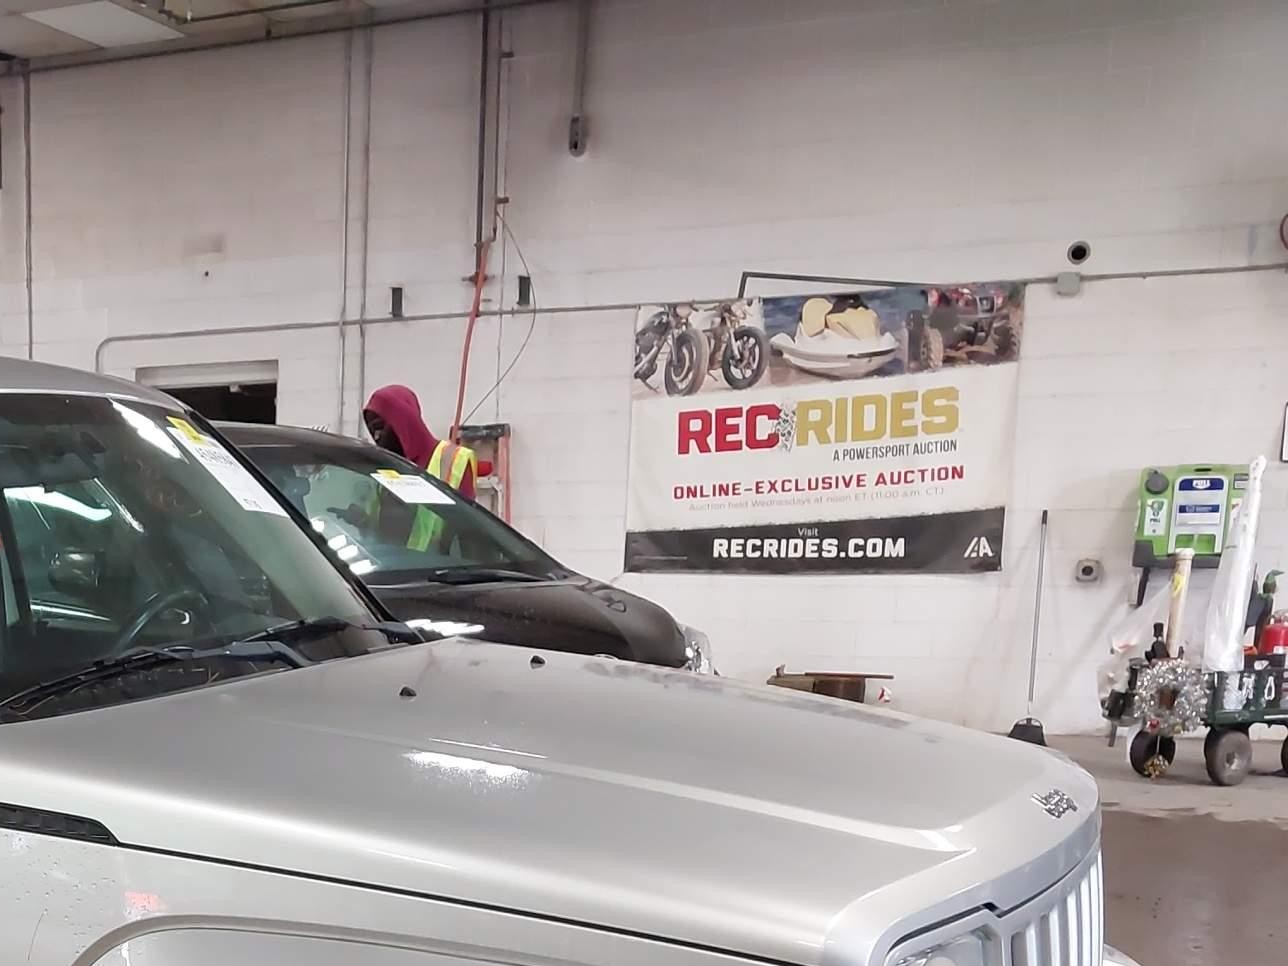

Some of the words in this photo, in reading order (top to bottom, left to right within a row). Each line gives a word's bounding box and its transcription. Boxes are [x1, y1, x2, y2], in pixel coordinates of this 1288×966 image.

[678, 403, 782, 455] REC
[795, 386, 960, 446] RIDES
[833, 449, 840, 462] A
[842, 443, 910, 461] POWERSPORT
[912, 439, 957, 456] AUCTION
[673, 473, 868, 500] ONLINE-EXCLUSIVE
[874, 465, 965, 487] AUCTION
[798, 527, 819, 537] Visit
[713, 537, 905, 558] RECRIDES.COM
